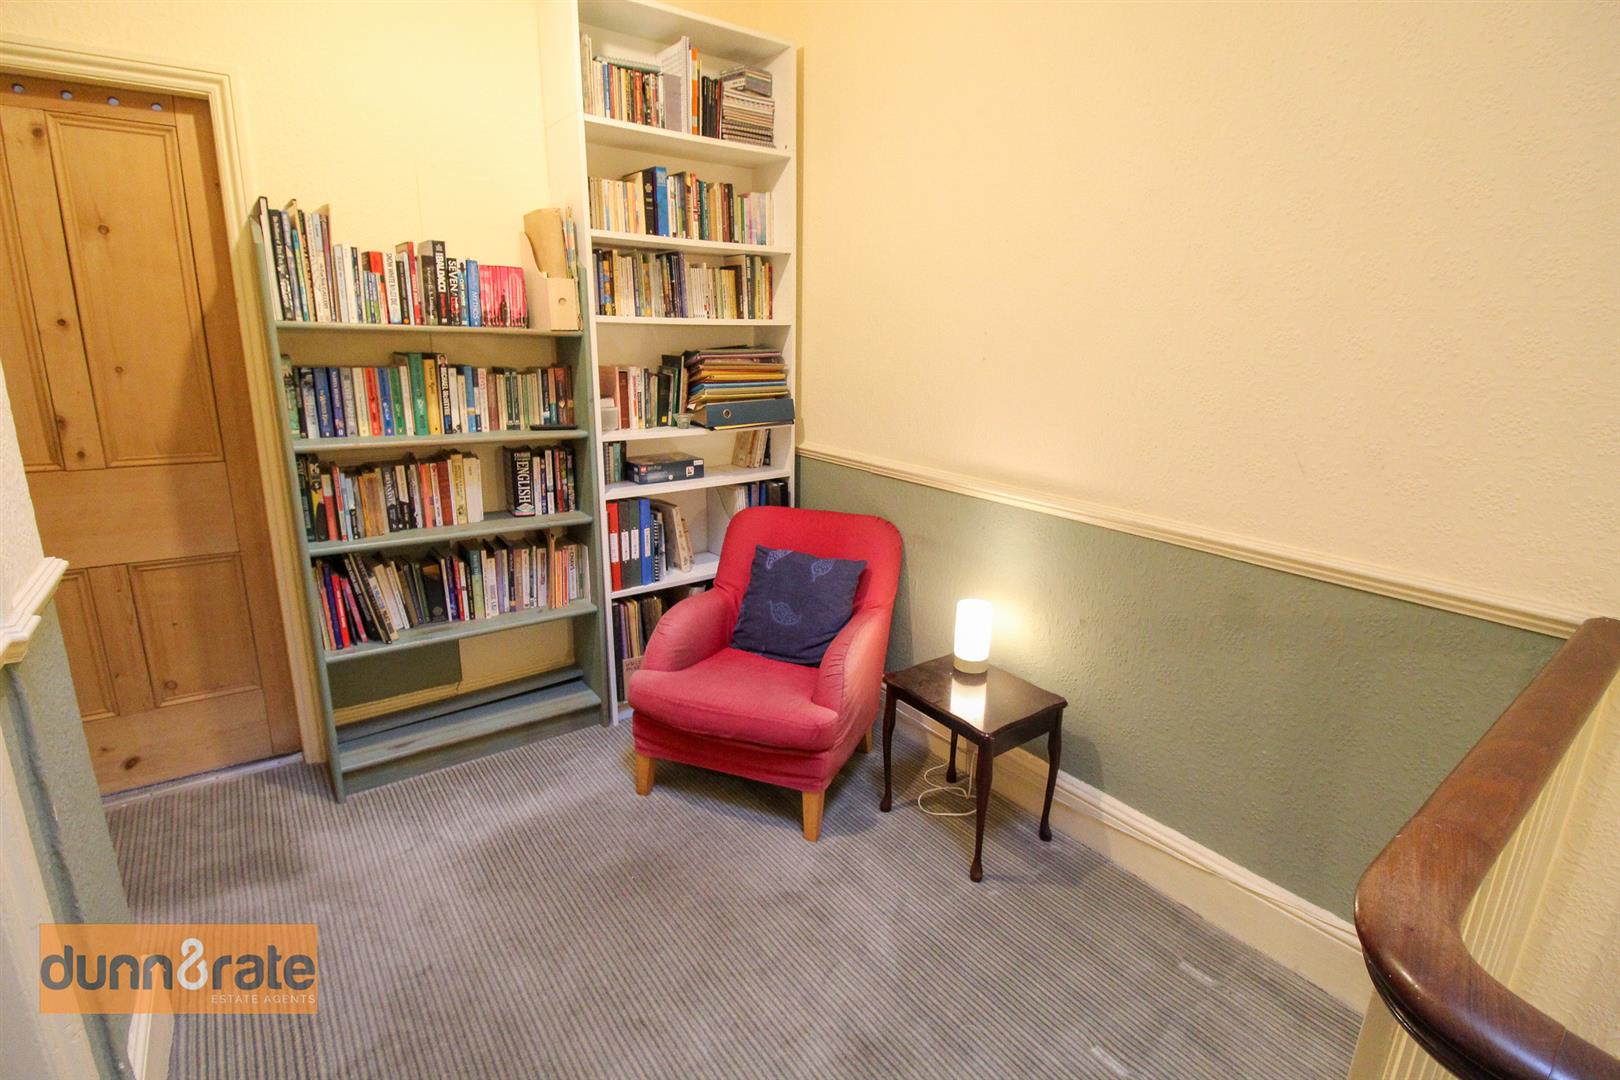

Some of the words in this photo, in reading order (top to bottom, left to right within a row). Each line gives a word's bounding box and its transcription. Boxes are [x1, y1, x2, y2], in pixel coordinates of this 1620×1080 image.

[436, 255, 446, 292] BALDACCI
[448, 260, 458, 292] SEVEN
[516, 461, 531, 505] ENGLISH
